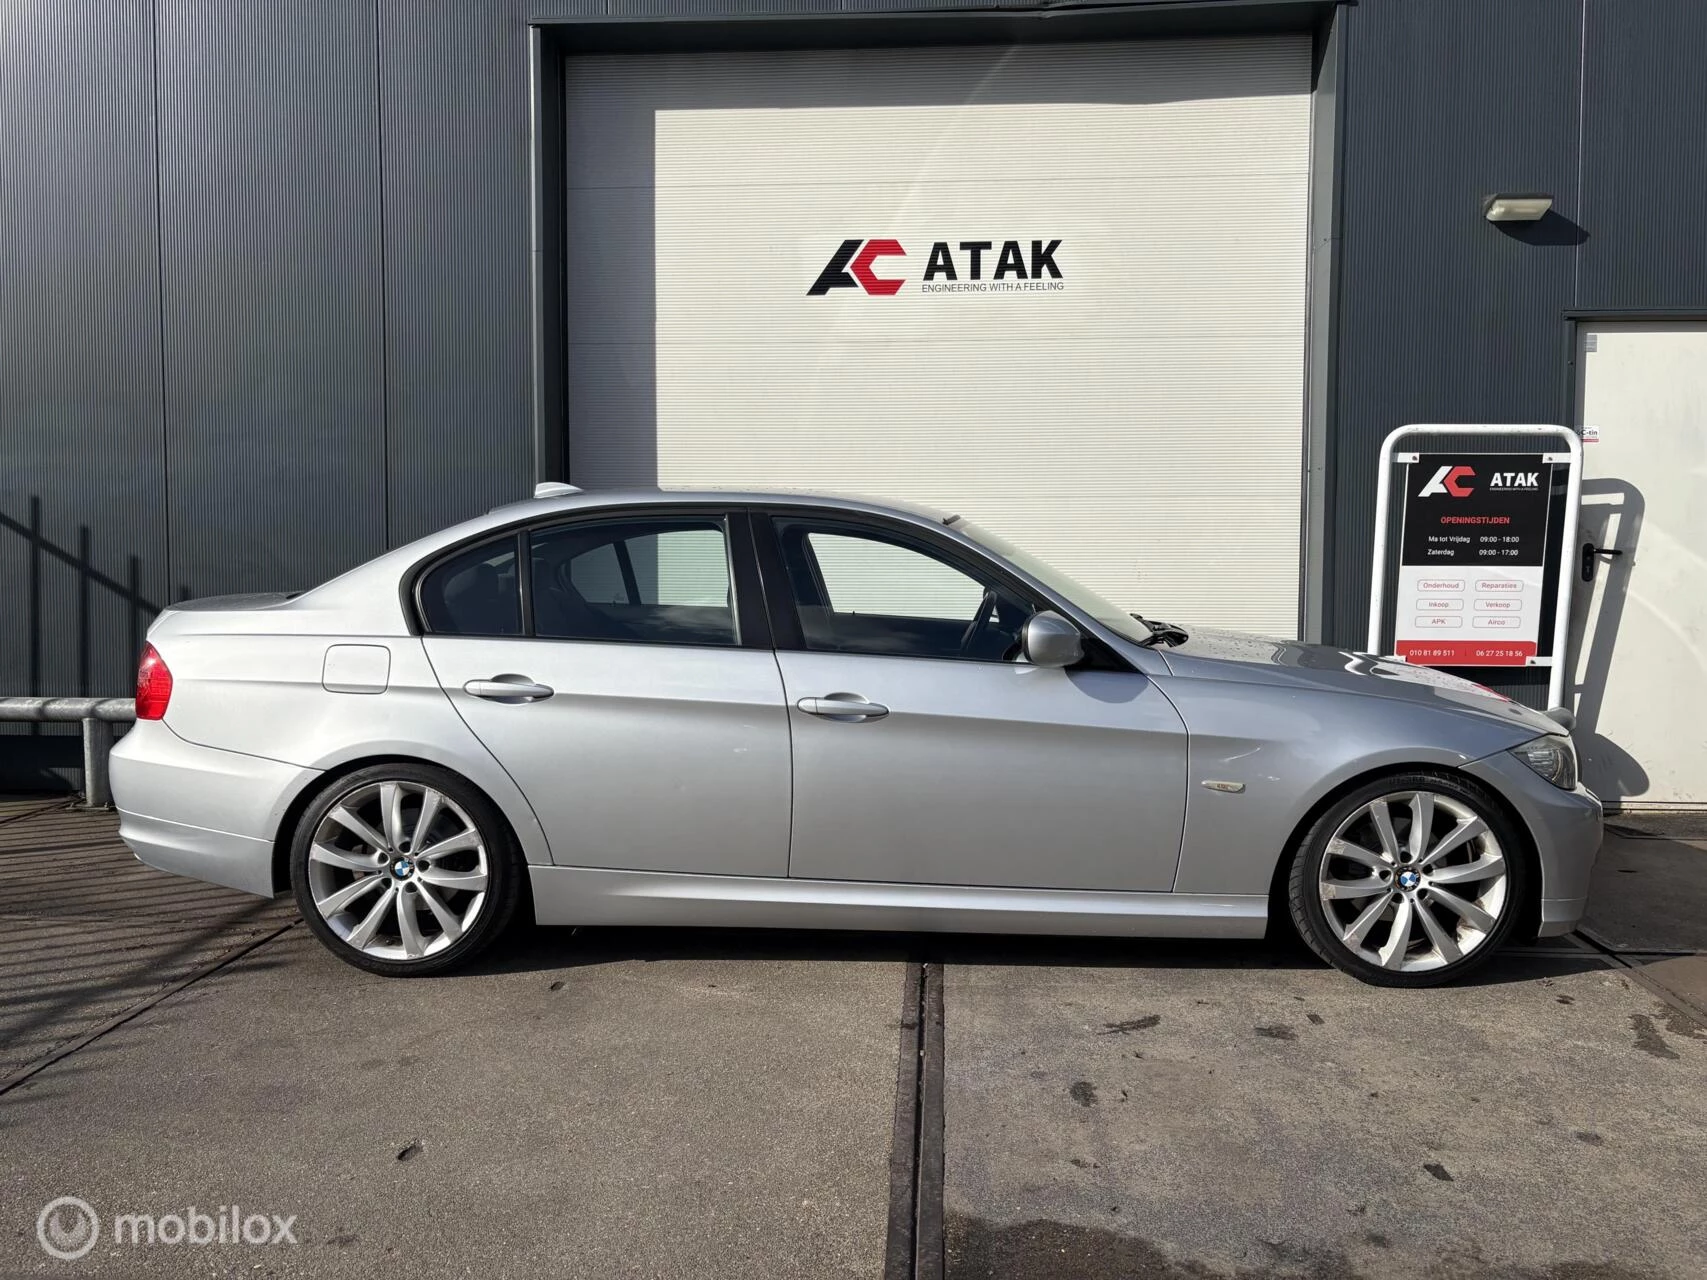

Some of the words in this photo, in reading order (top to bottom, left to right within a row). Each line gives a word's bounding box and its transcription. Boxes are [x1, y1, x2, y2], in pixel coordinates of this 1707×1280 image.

[923, 240, 1064, 281] ATAK
[921, 283, 987, 293] ENGINEERING
[988, 283, 1014, 292] WITH
[1015, 282, 1022, 292] A
[1023, 281, 1065, 291] FEELING
[1490, 472, 1539, 487] ATAK
[1440, 516, 1510, 524] OPENINGSTIJDEN
[1449, 536, 1471, 544] Vrijdag
[1481, 582, 1517, 590] Reparaties
[1485, 601, 1511, 609] Verkoop
